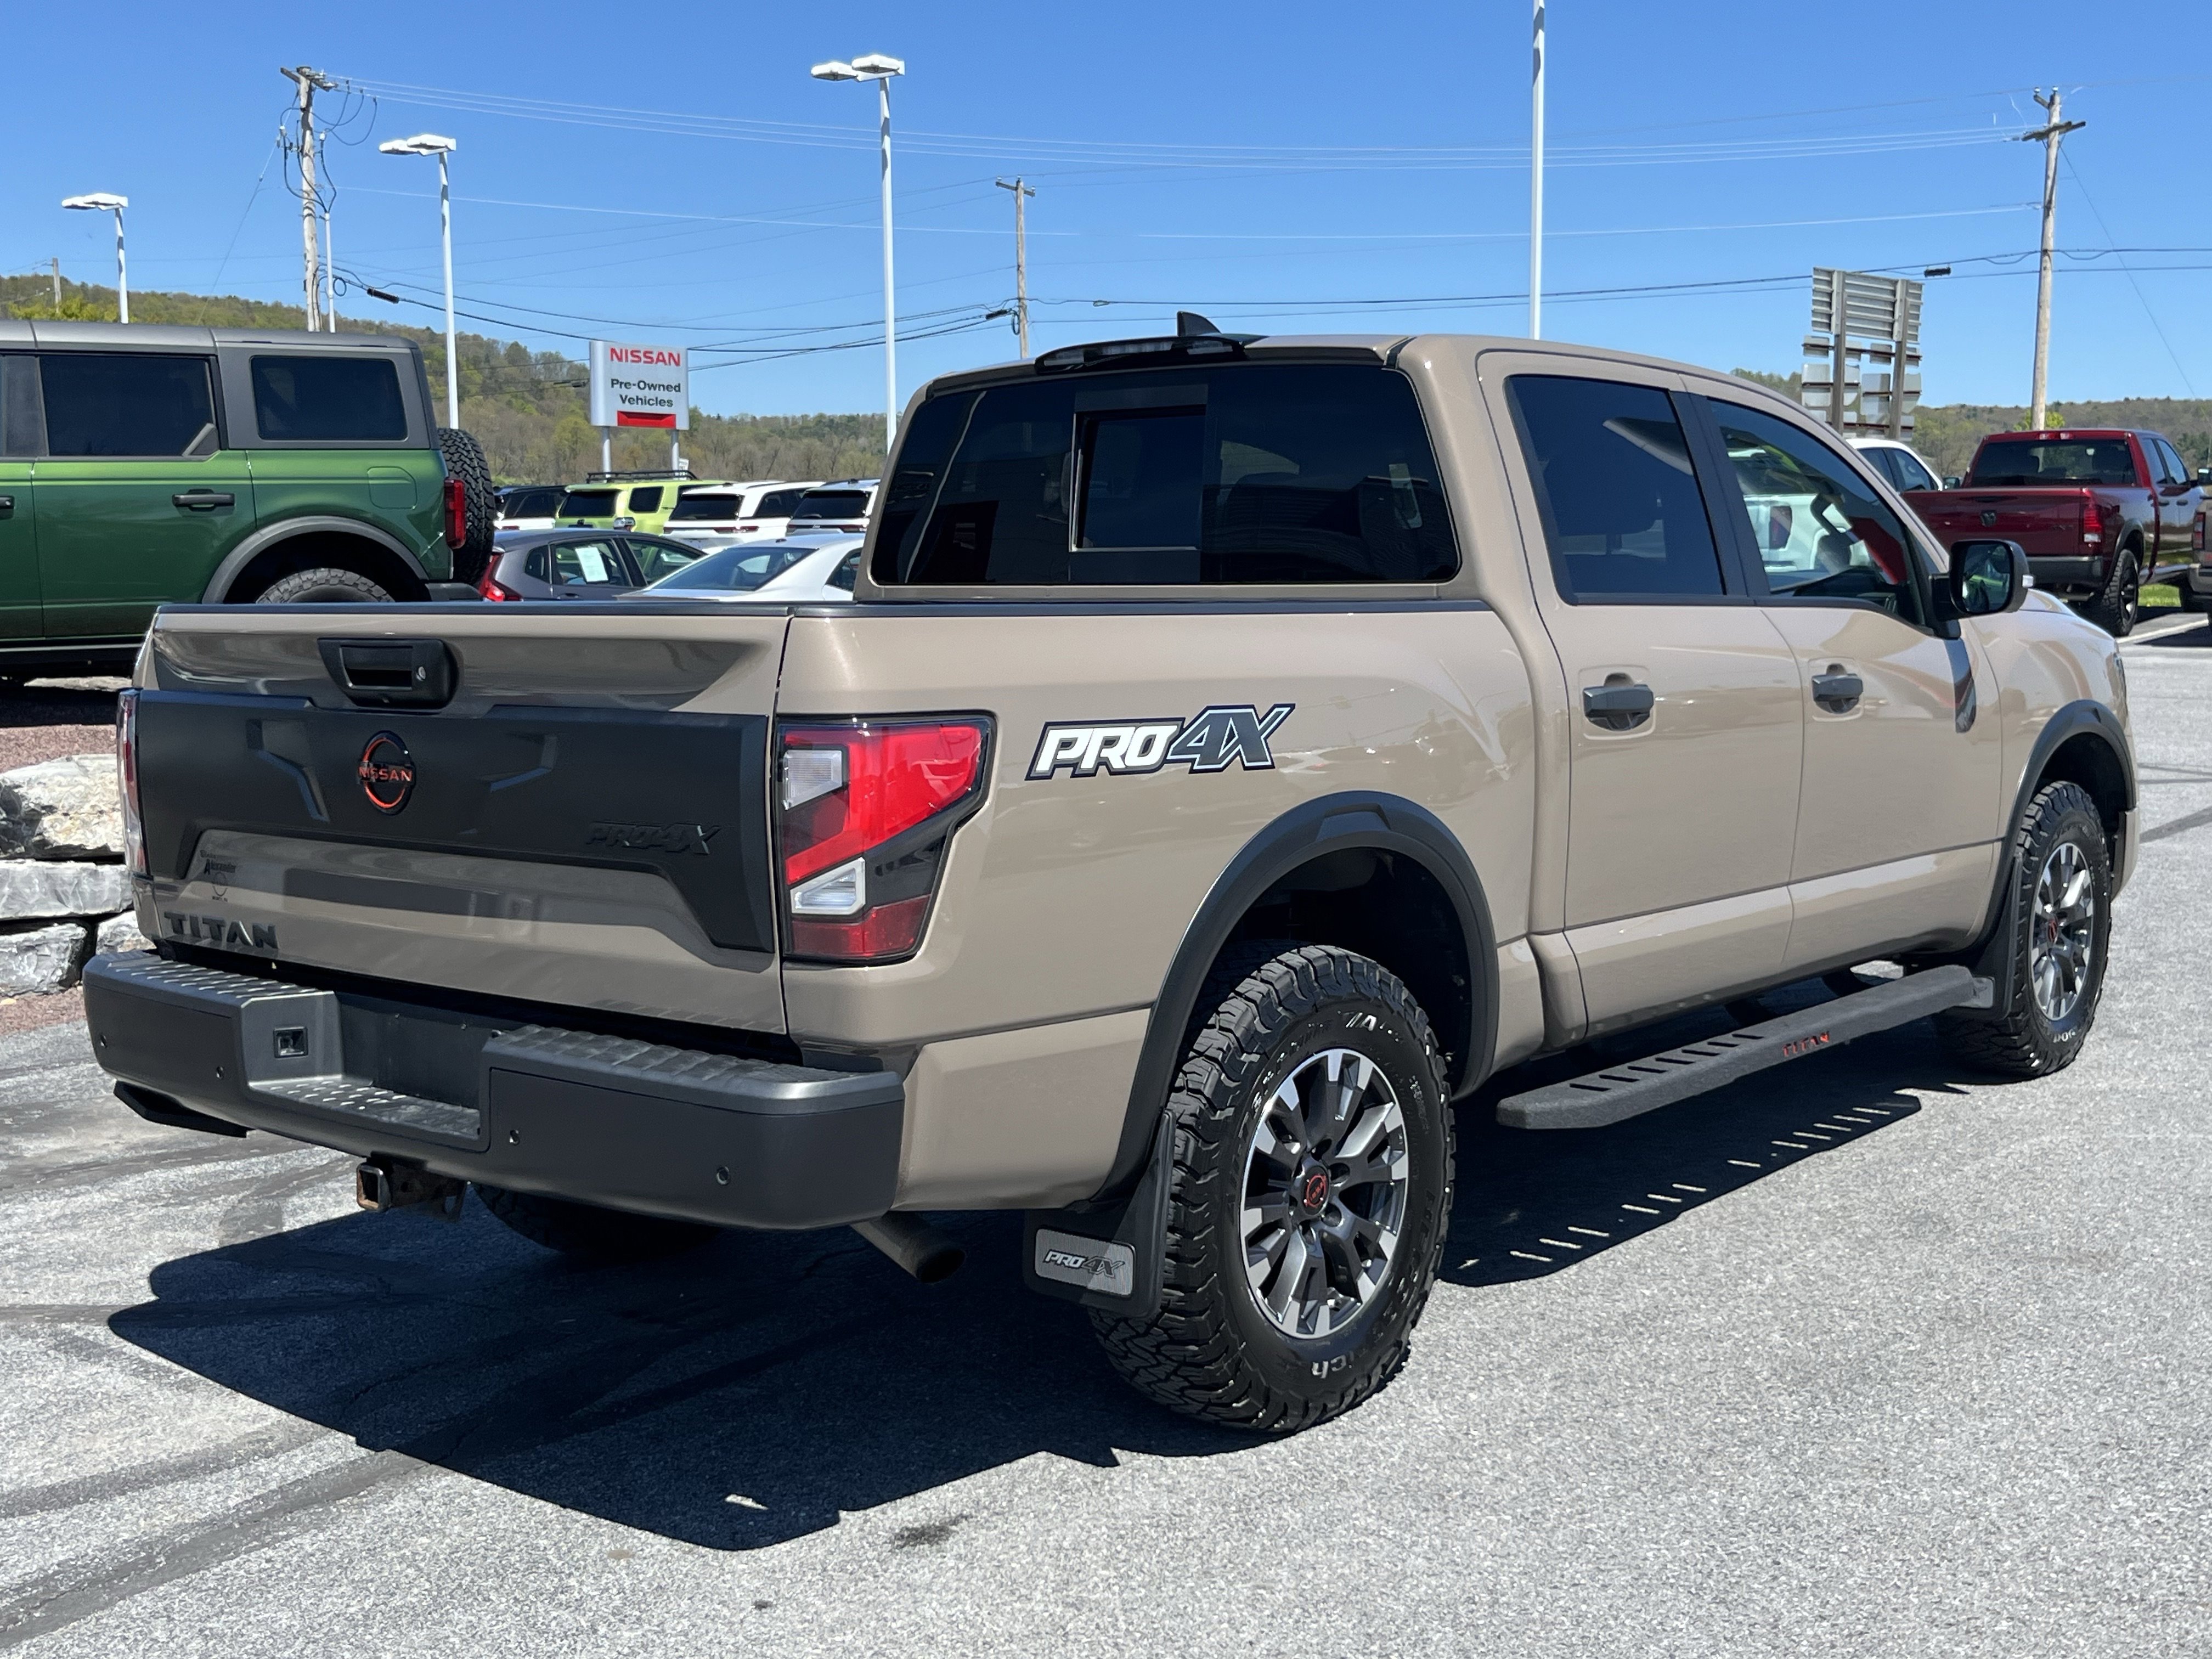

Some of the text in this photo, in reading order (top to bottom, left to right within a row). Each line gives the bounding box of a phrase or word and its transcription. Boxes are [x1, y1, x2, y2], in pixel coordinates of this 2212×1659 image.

[610, 347, 680, 366] NISSAN
[611, 379, 681, 392] Pre-Owned
[619, 394, 673, 407] Vehicles
[1025, 703, 1296, 780] PRO4X
[163, 911, 278, 949] TITAN
[1783, 1031, 1830, 1057] TITAN
[1044, 1249, 1125, 1279] PRO4X
